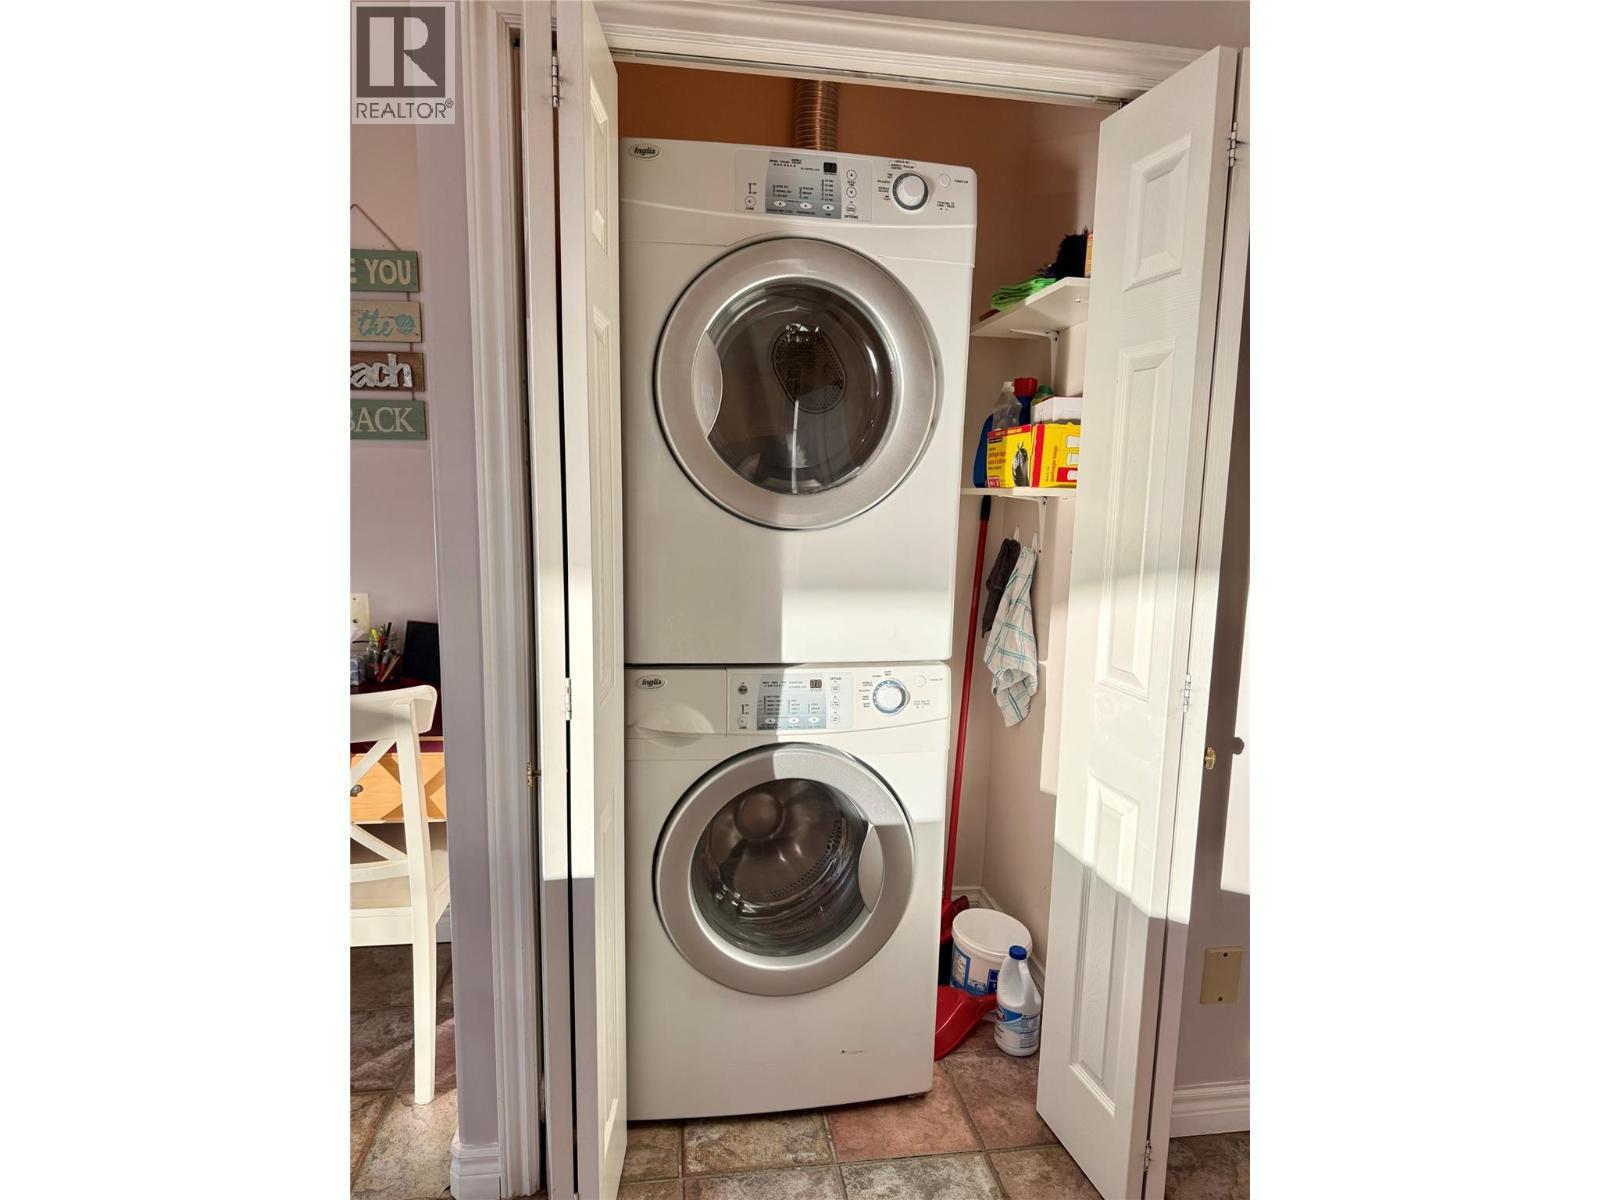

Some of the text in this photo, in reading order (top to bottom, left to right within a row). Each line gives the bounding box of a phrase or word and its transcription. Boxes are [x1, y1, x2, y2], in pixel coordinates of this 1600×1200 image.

[633, 145, 656, 156] Inglis
[363, 257, 411, 285] YOU
[357, 307, 394, 337] the
[350, 353, 413, 388] ach
[641, 678, 662, 688] Inglis
